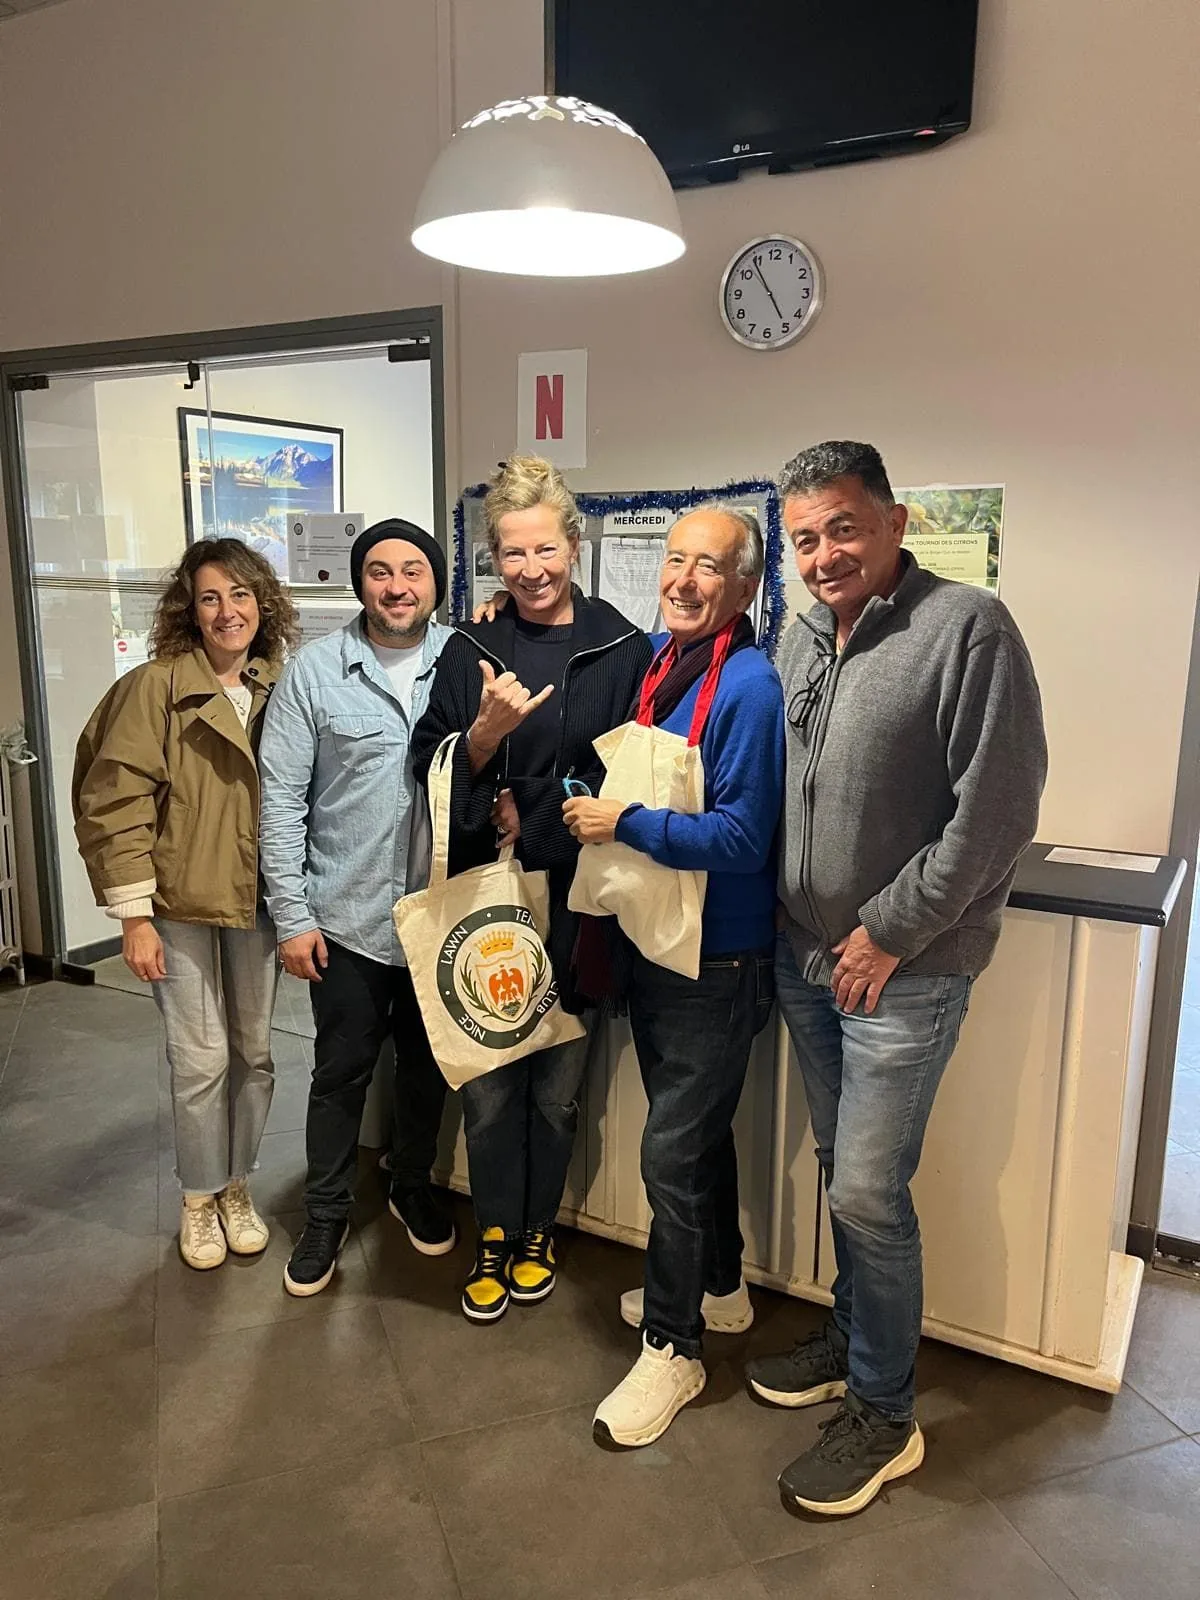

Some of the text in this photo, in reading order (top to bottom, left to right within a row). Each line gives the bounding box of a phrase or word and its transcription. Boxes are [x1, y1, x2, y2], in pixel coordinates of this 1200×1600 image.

[768, 249, 782, 260] 12
[788, 253, 794, 264] 1
[753, 256, 762, 266] 11
[740, 269, 753, 281] 10
[798, 268, 807, 280] 2
[734, 289, 743, 300] 9
[801, 288, 810, 299] 3
[736, 309, 745, 320] 8
[794, 308, 802, 319] 4
[748, 323, 757, 334] 7
[763, 328, 772, 339] 6
[781, 323, 790, 334] 5
[536, 374, 564, 440] N
[613, 516, 665, 525] MERCREDI
[440, 925, 469, 965] LAWN
[458, 1013, 486, 1041] NICE
